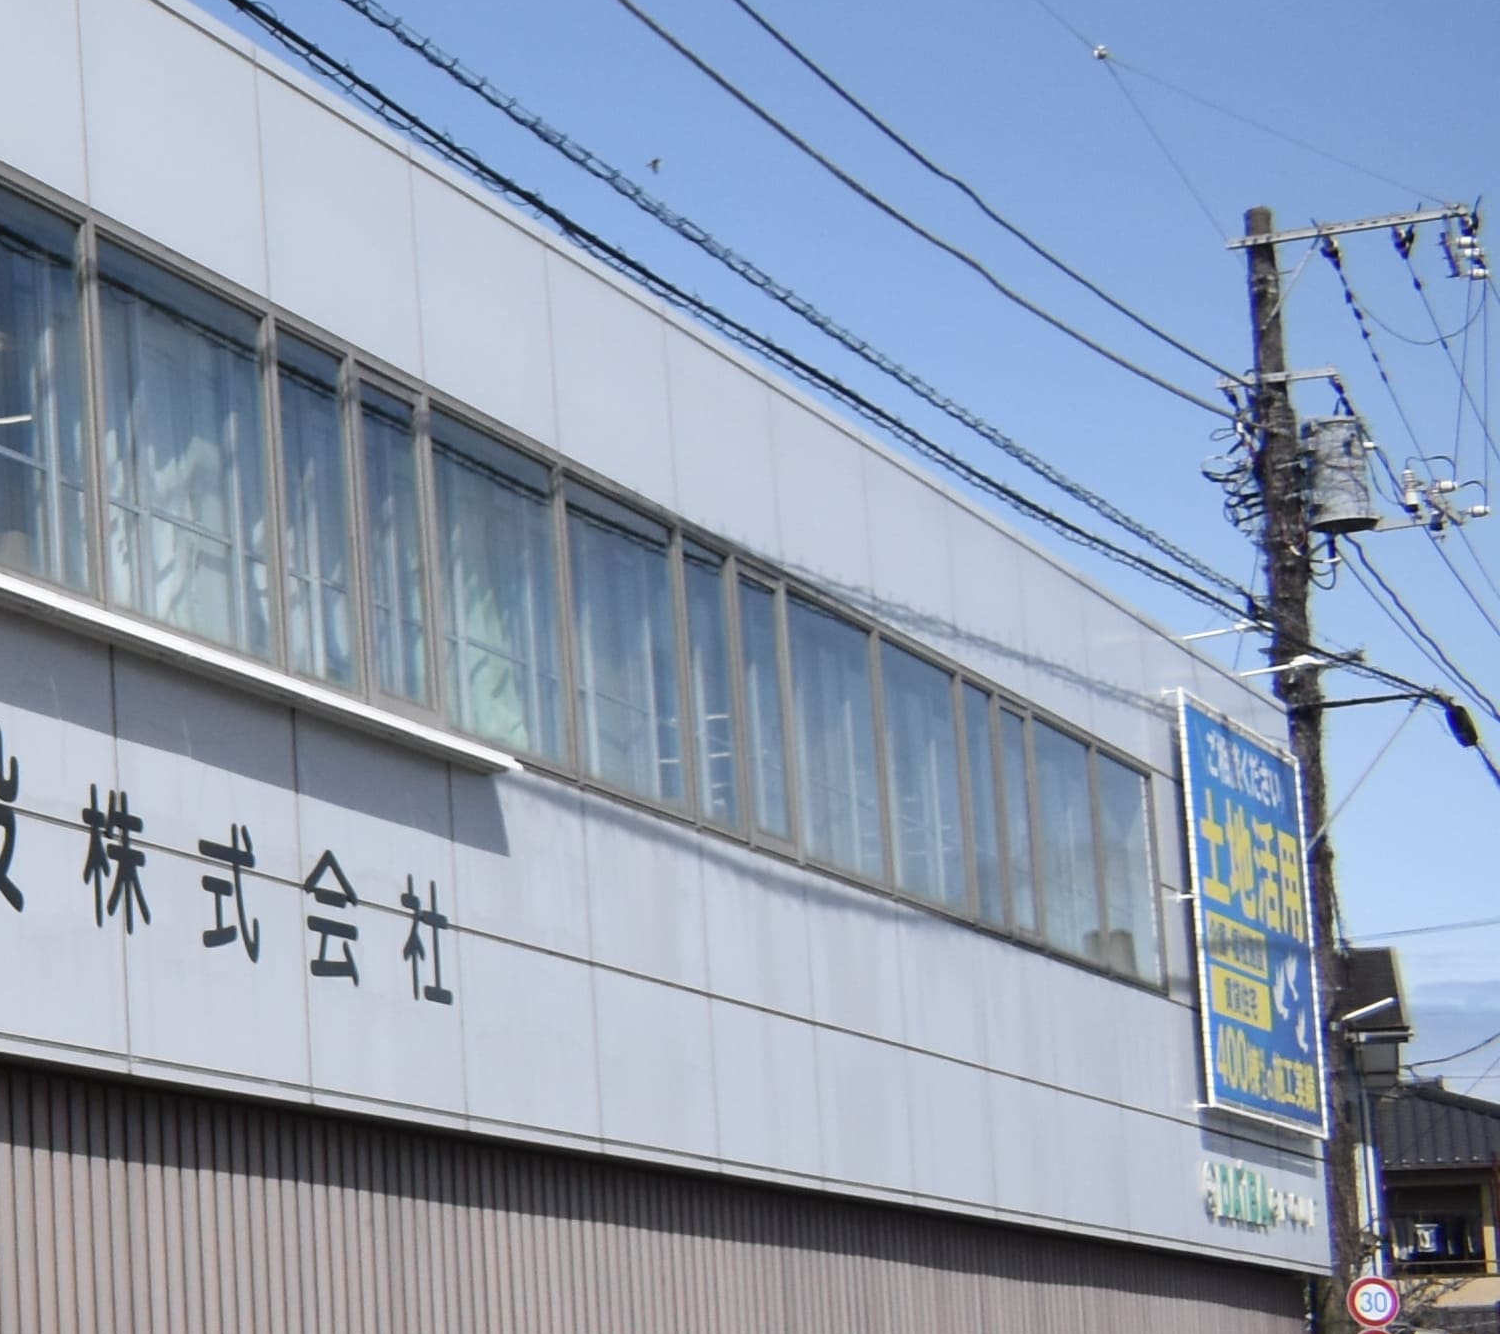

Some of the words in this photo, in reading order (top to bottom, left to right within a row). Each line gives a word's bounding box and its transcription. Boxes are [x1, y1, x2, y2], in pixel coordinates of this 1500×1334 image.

[1201, 788, 1304, 943] 土地活用
[1360, 1291, 1388, 1313] 30
